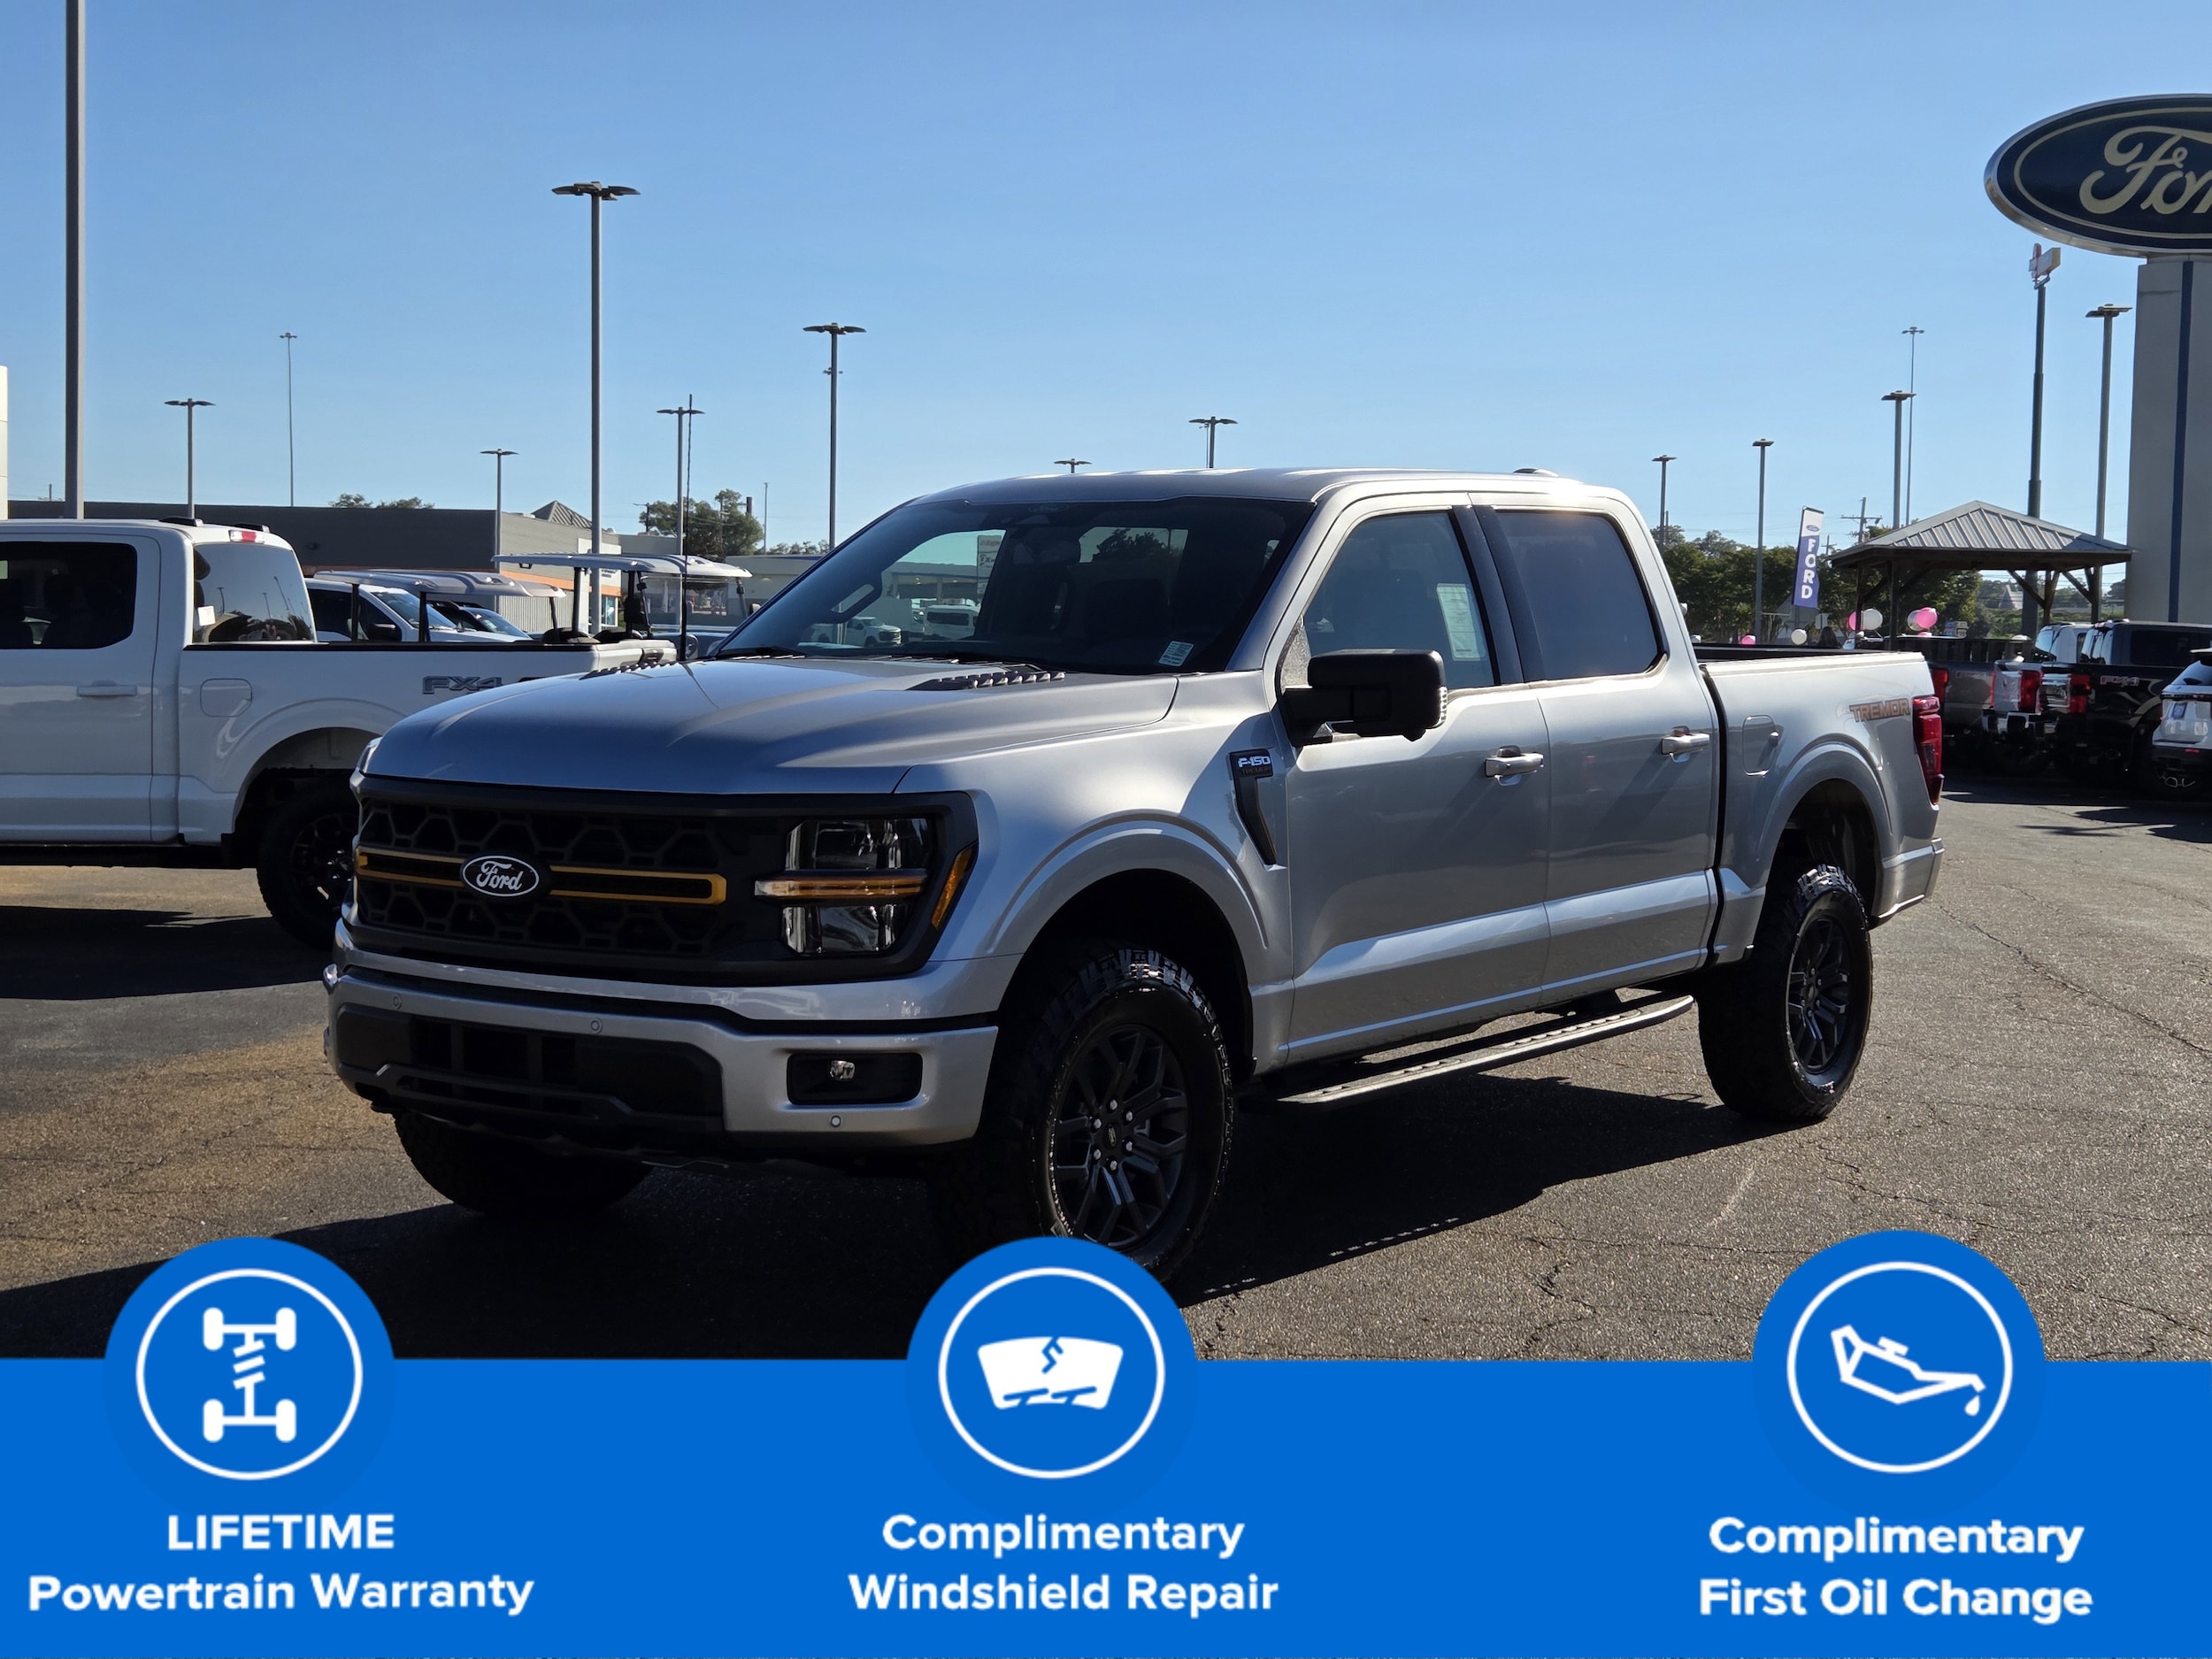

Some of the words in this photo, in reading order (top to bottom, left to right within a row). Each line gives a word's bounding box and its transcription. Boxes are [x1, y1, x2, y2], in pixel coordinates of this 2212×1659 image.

[1801, 538, 1816, 599] FORD
[1849, 697, 1911, 722] TREMOR
[1238, 756, 1271, 768] F-150
[476, 860, 524, 891] Ford
